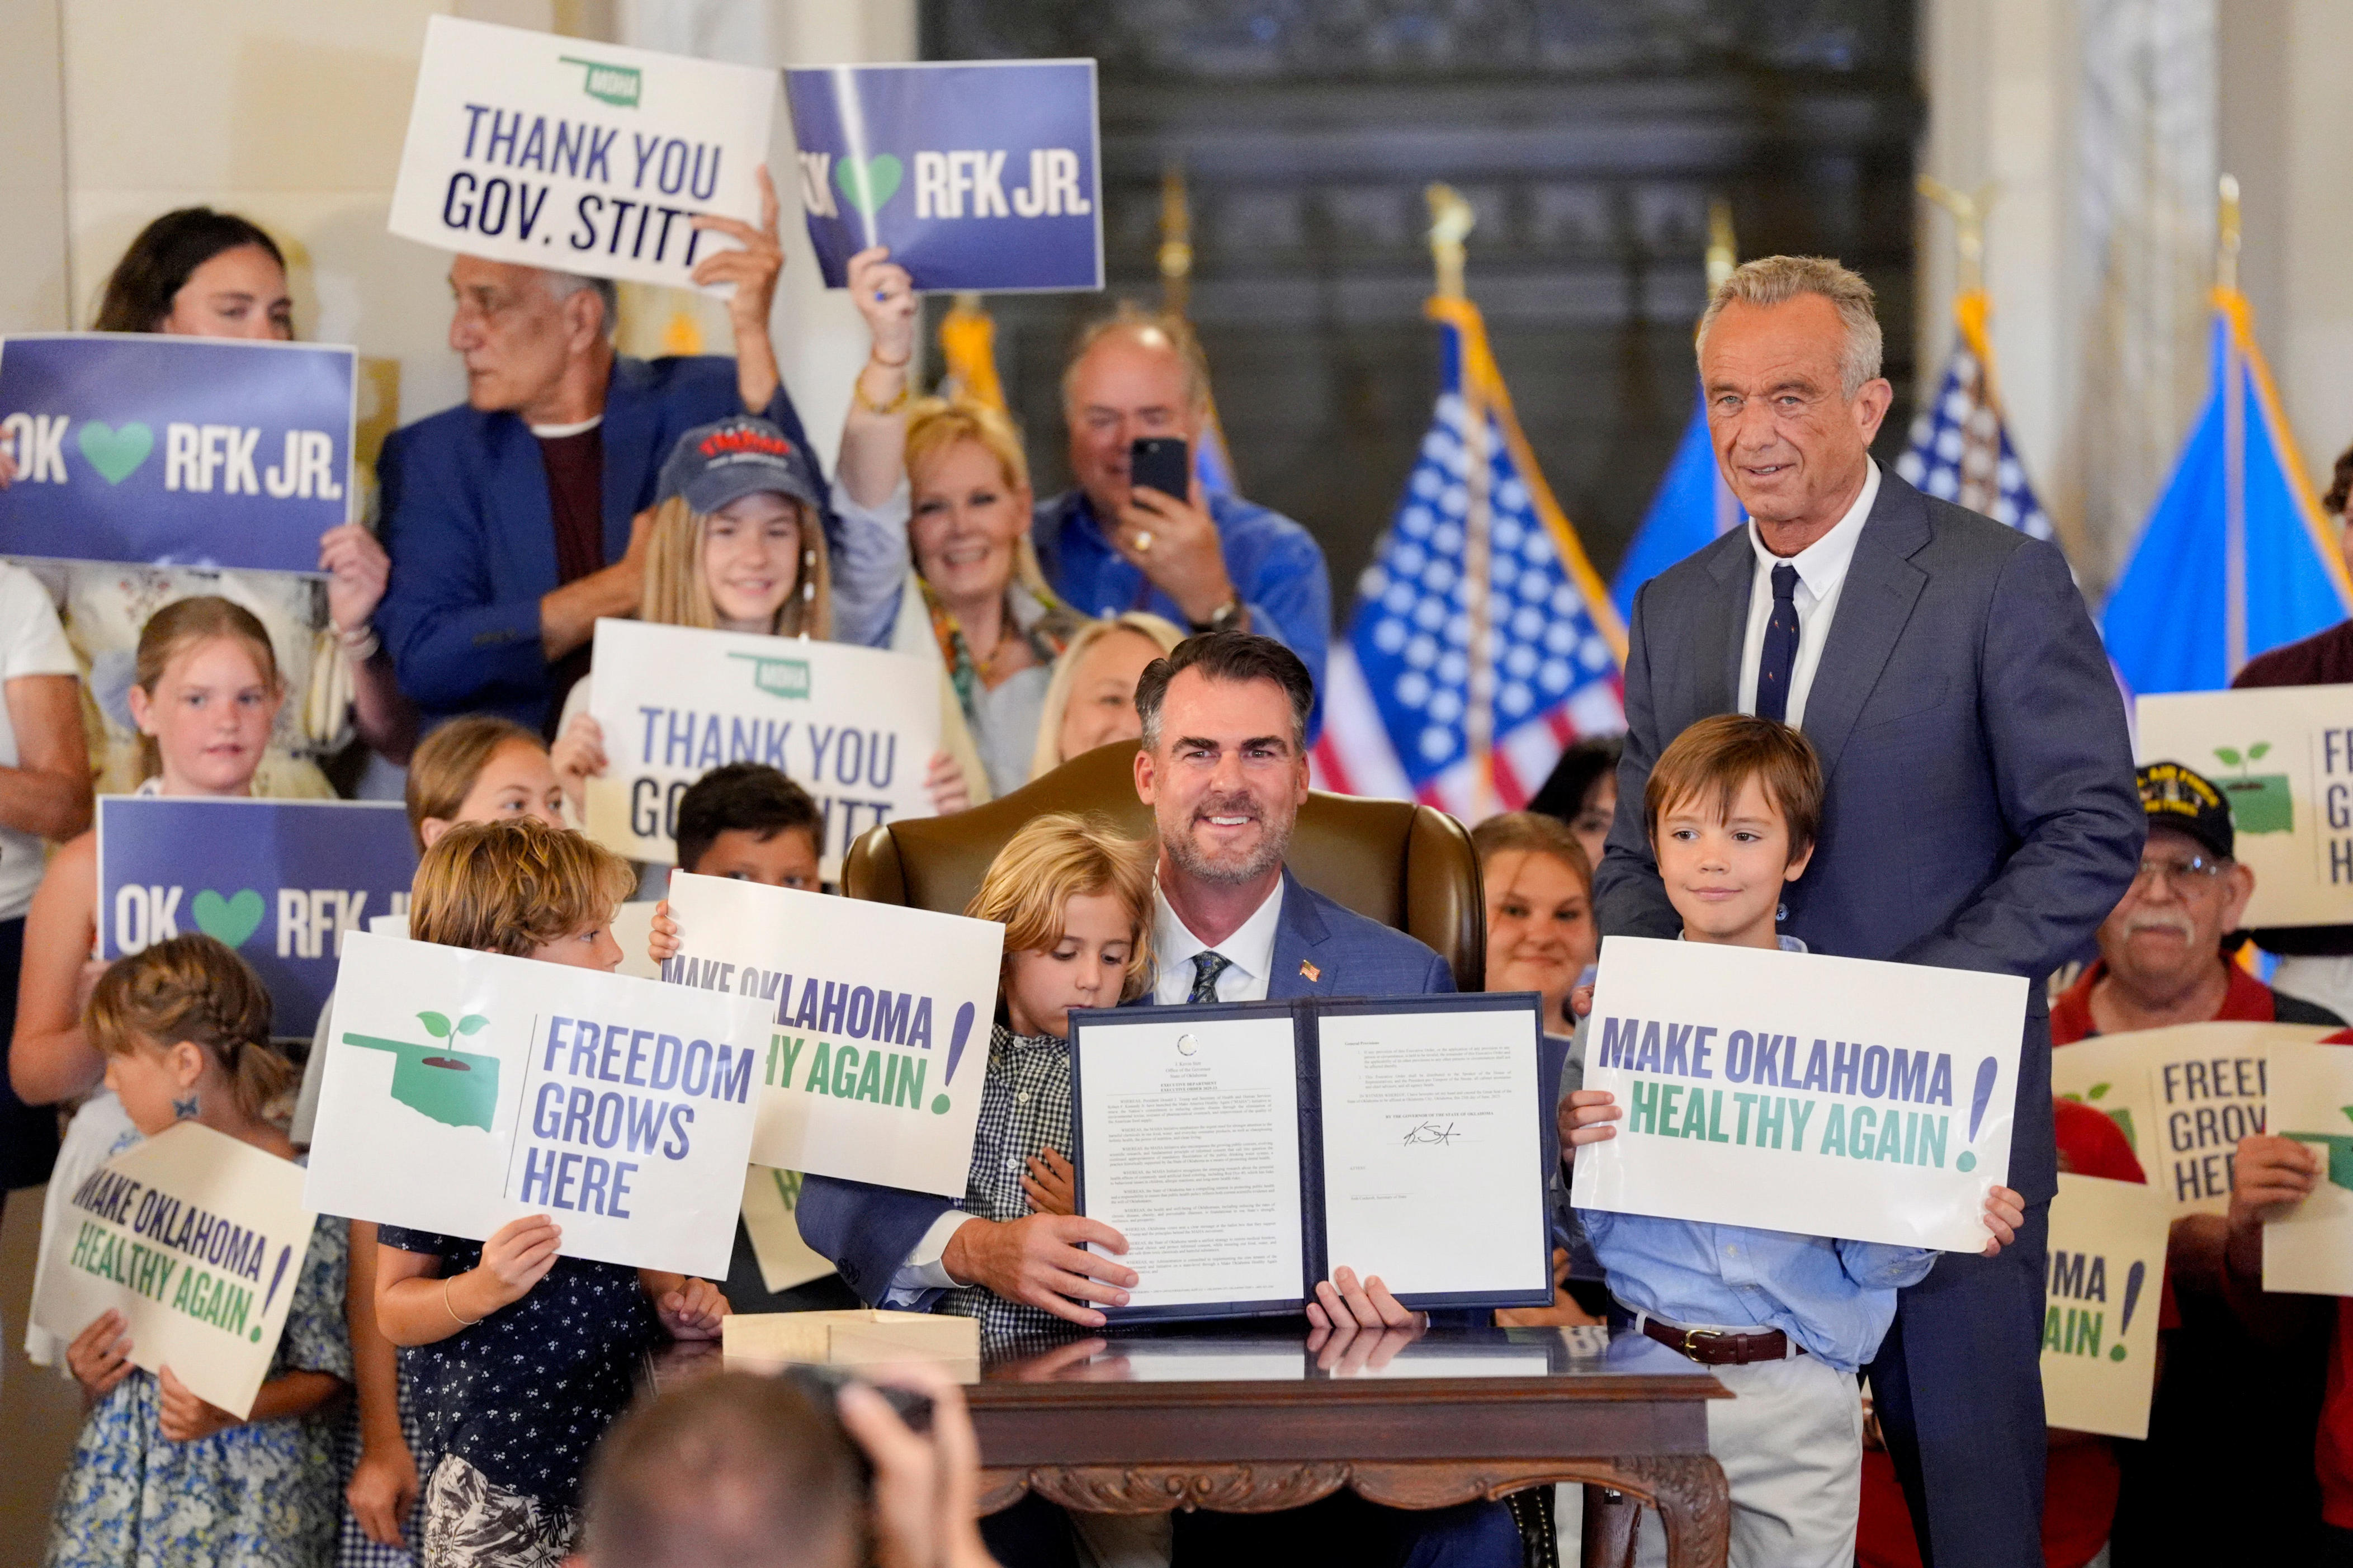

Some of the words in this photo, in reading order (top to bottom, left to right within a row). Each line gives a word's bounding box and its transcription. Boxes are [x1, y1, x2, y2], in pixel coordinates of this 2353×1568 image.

[465, 105, 618, 183] THANK
[634, 133, 721, 200] YOU
[915, 149, 1010, 219] RFK
[1013, 148, 1092, 219] JR.
[443, 171, 550, 245] GOV.
[165, 422, 262, 495] RFK
[264, 429, 343, 499] JR.
[639, 707, 792, 772] THANK
[808, 723, 896, 788] YOU
[116, 884, 184, 953] OK
[277, 889, 368, 958] RFK
[739, 966, 933, 1050] OKLAHOMA
[542, 1016, 755, 1103] FREEDOM
[1599, 1017, 1718, 1079] MAKE
[1725, 1029, 1953, 1107] OKLAHOMA
[532, 1082, 694, 1161] GROWS
[1628, 1080, 1815, 1151] HEALTHY
[520, 1147, 639, 1219] HERE
[70, 1221, 177, 1302] HEALTHY
[72, 1169, 141, 1225] MAKE
[134, 1189, 267, 1282] OKLAHOMA
